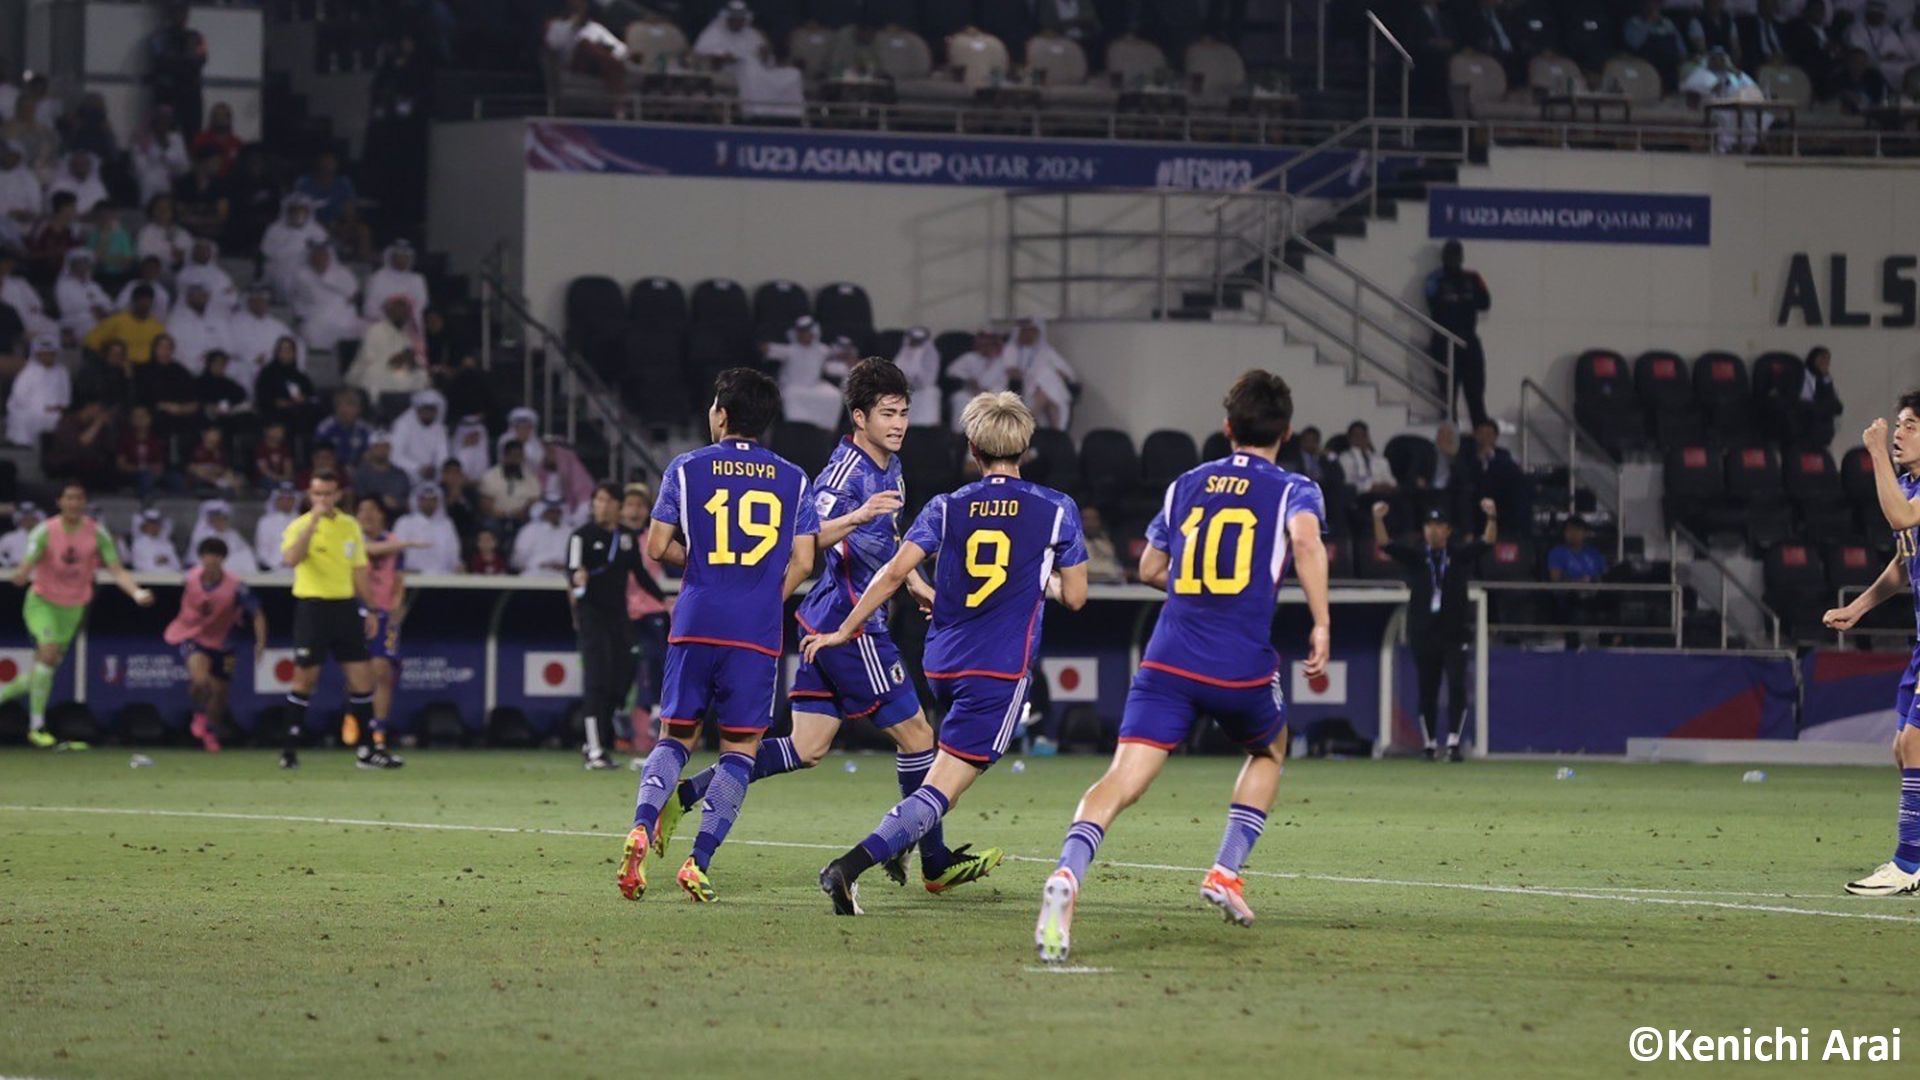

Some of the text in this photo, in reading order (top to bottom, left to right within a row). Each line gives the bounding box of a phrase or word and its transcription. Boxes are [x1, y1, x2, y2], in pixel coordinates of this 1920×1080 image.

[801, 148, 884, 174] ASIAN
[886, 151, 943, 176] CUP
[947, 153, 1030, 182] QATAR
[1035, 156, 1094, 181] 2024
[1502, 206, 1554, 227] ASIAN
[1556, 208, 1594, 228] CUP
[1597, 209, 1650, 231] QATAR
[1655, 211, 1693, 231] 2024
[712, 459, 777, 480] HOSOYA
[1204, 474, 1250, 496] SATO
[968, 499, 1019, 518] FUJIO
[703, 487, 783, 567] 19
[1173, 506, 1259, 596] 10
[964, 528, 1012, 609] 9
